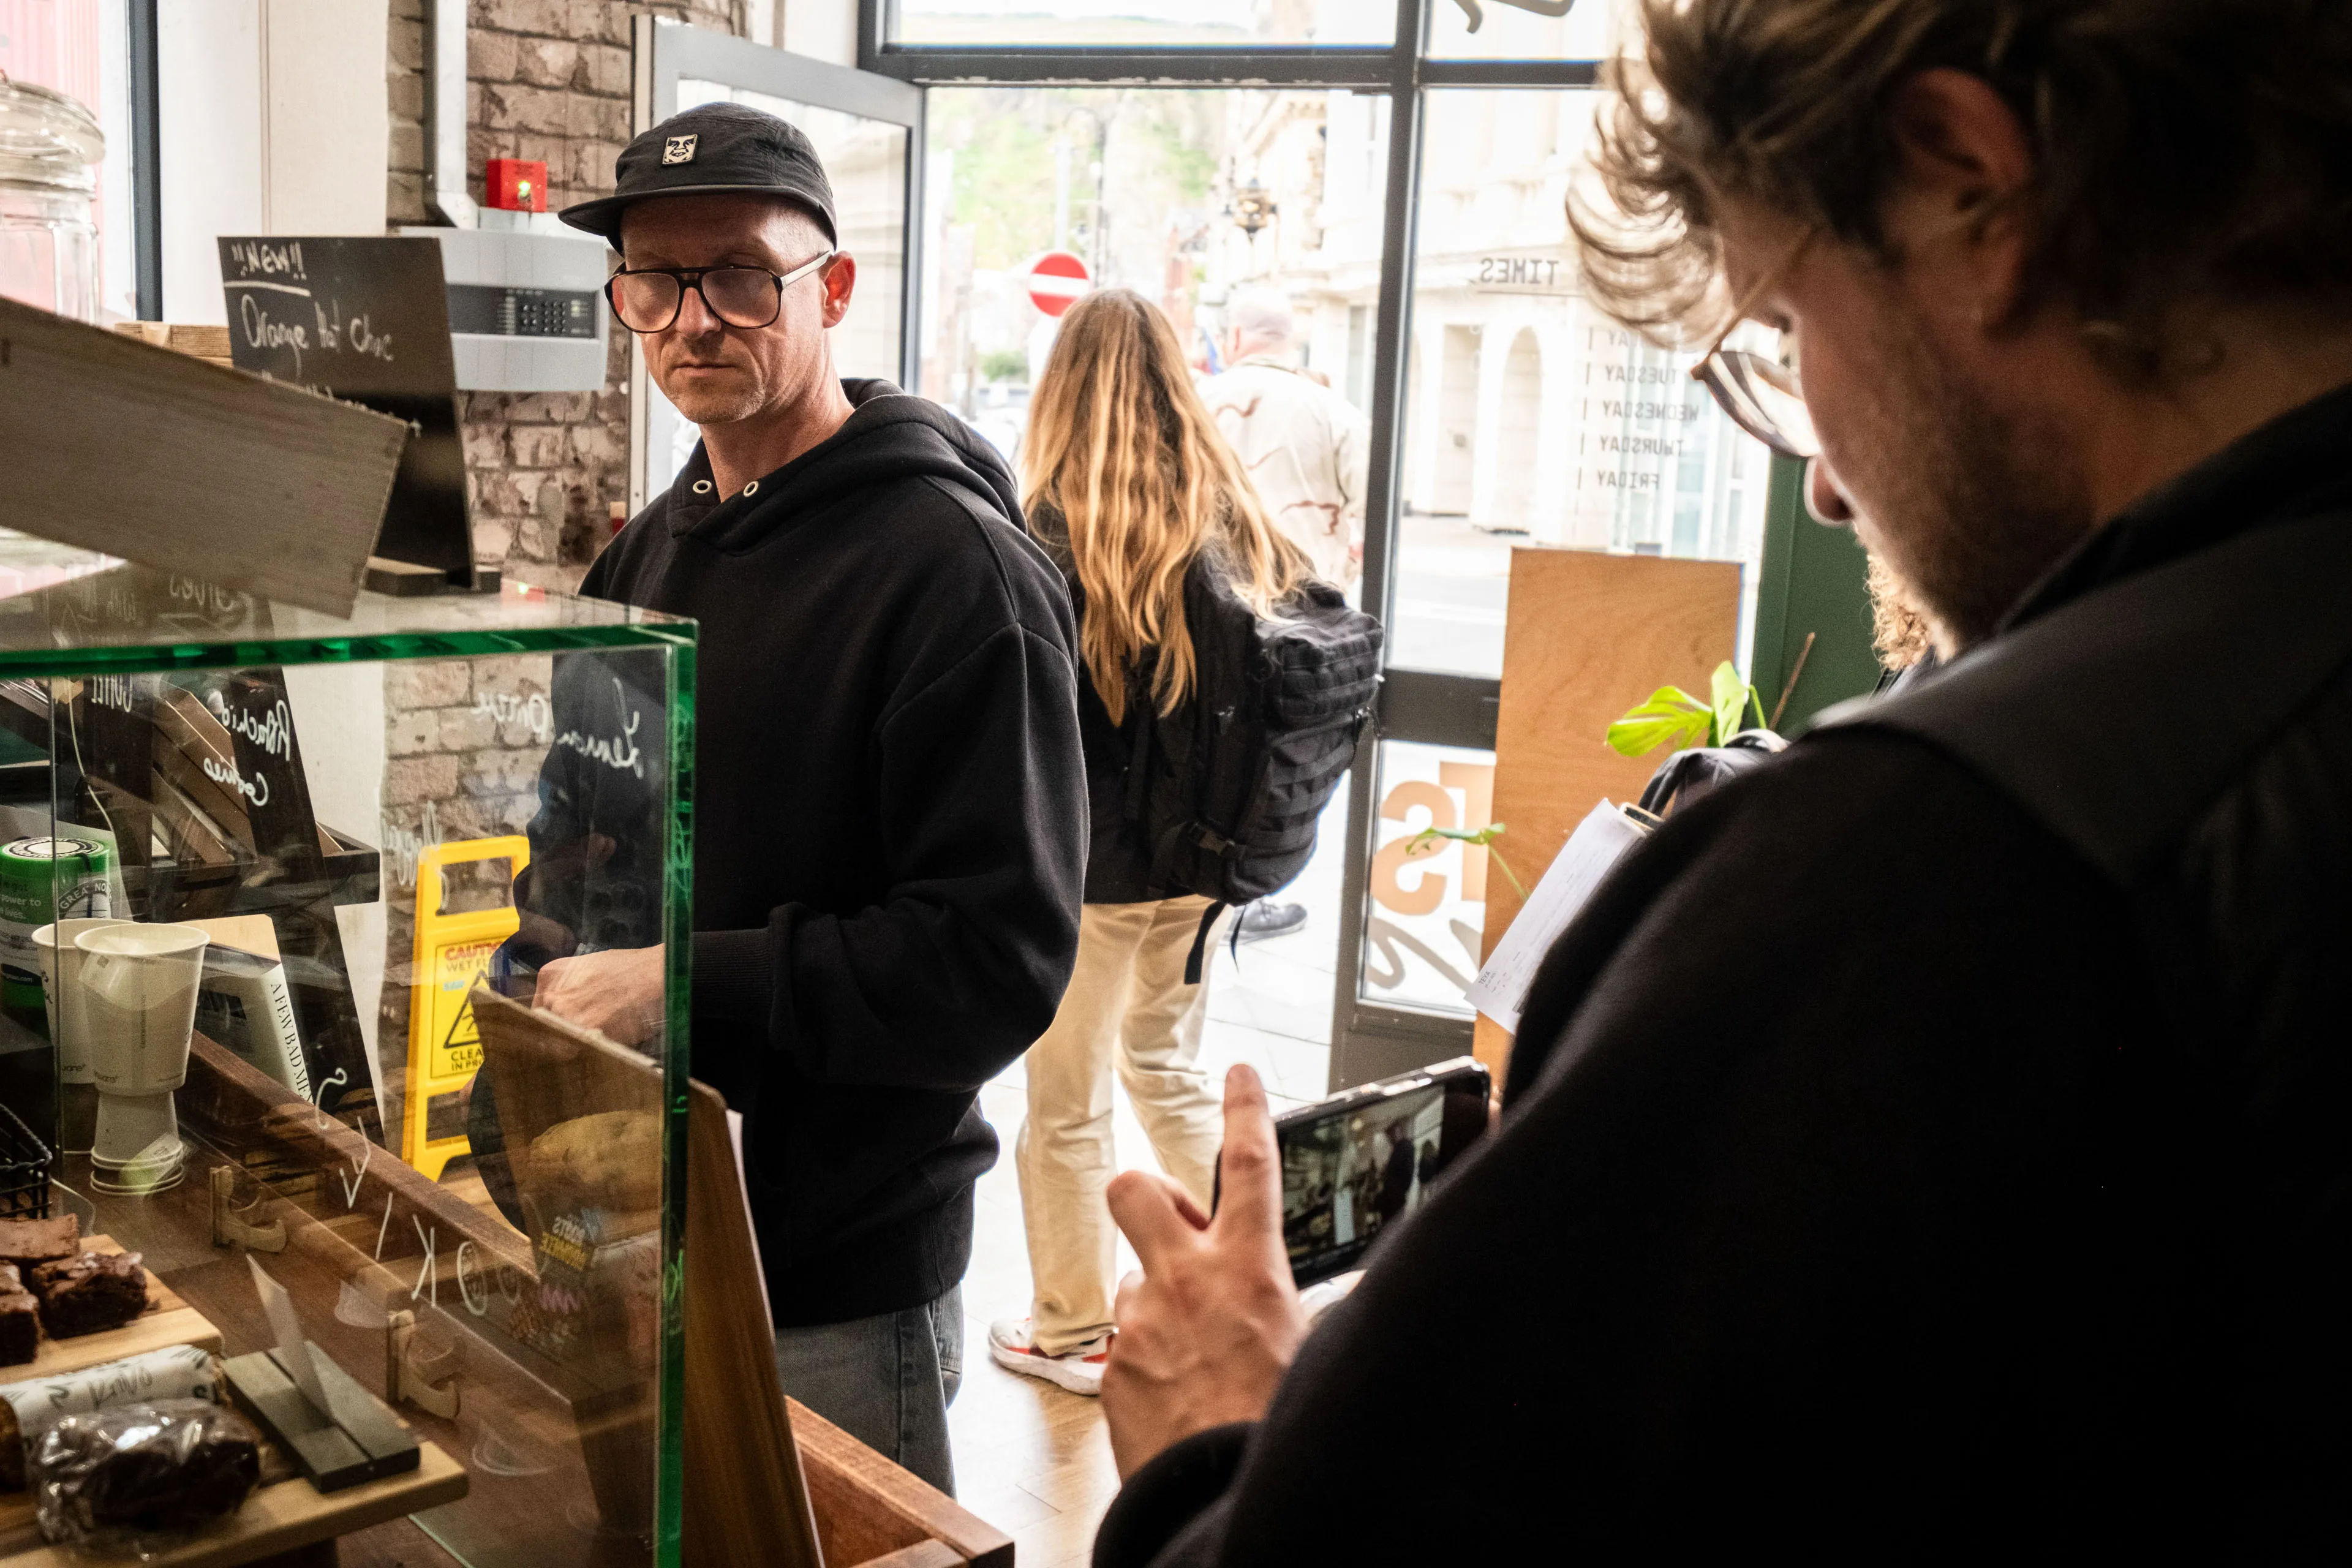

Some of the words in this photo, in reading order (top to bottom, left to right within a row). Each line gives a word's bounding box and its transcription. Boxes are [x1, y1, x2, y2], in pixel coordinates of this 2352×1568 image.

[241, 294, 309, 379] Orange
[314, 300, 341, 353] Hot
[29, 897, 42, 907] to
[60, 886, 89, 910] GREA
[447, 960, 471, 972] WET
[271, 983, 282, 994] A
[274, 995, 293, 1029] FEW
[284, 1032, 303, 1068] BAD
[451, 1048, 483, 1061] CLEA
[451, 1061, 462, 1071] IN
